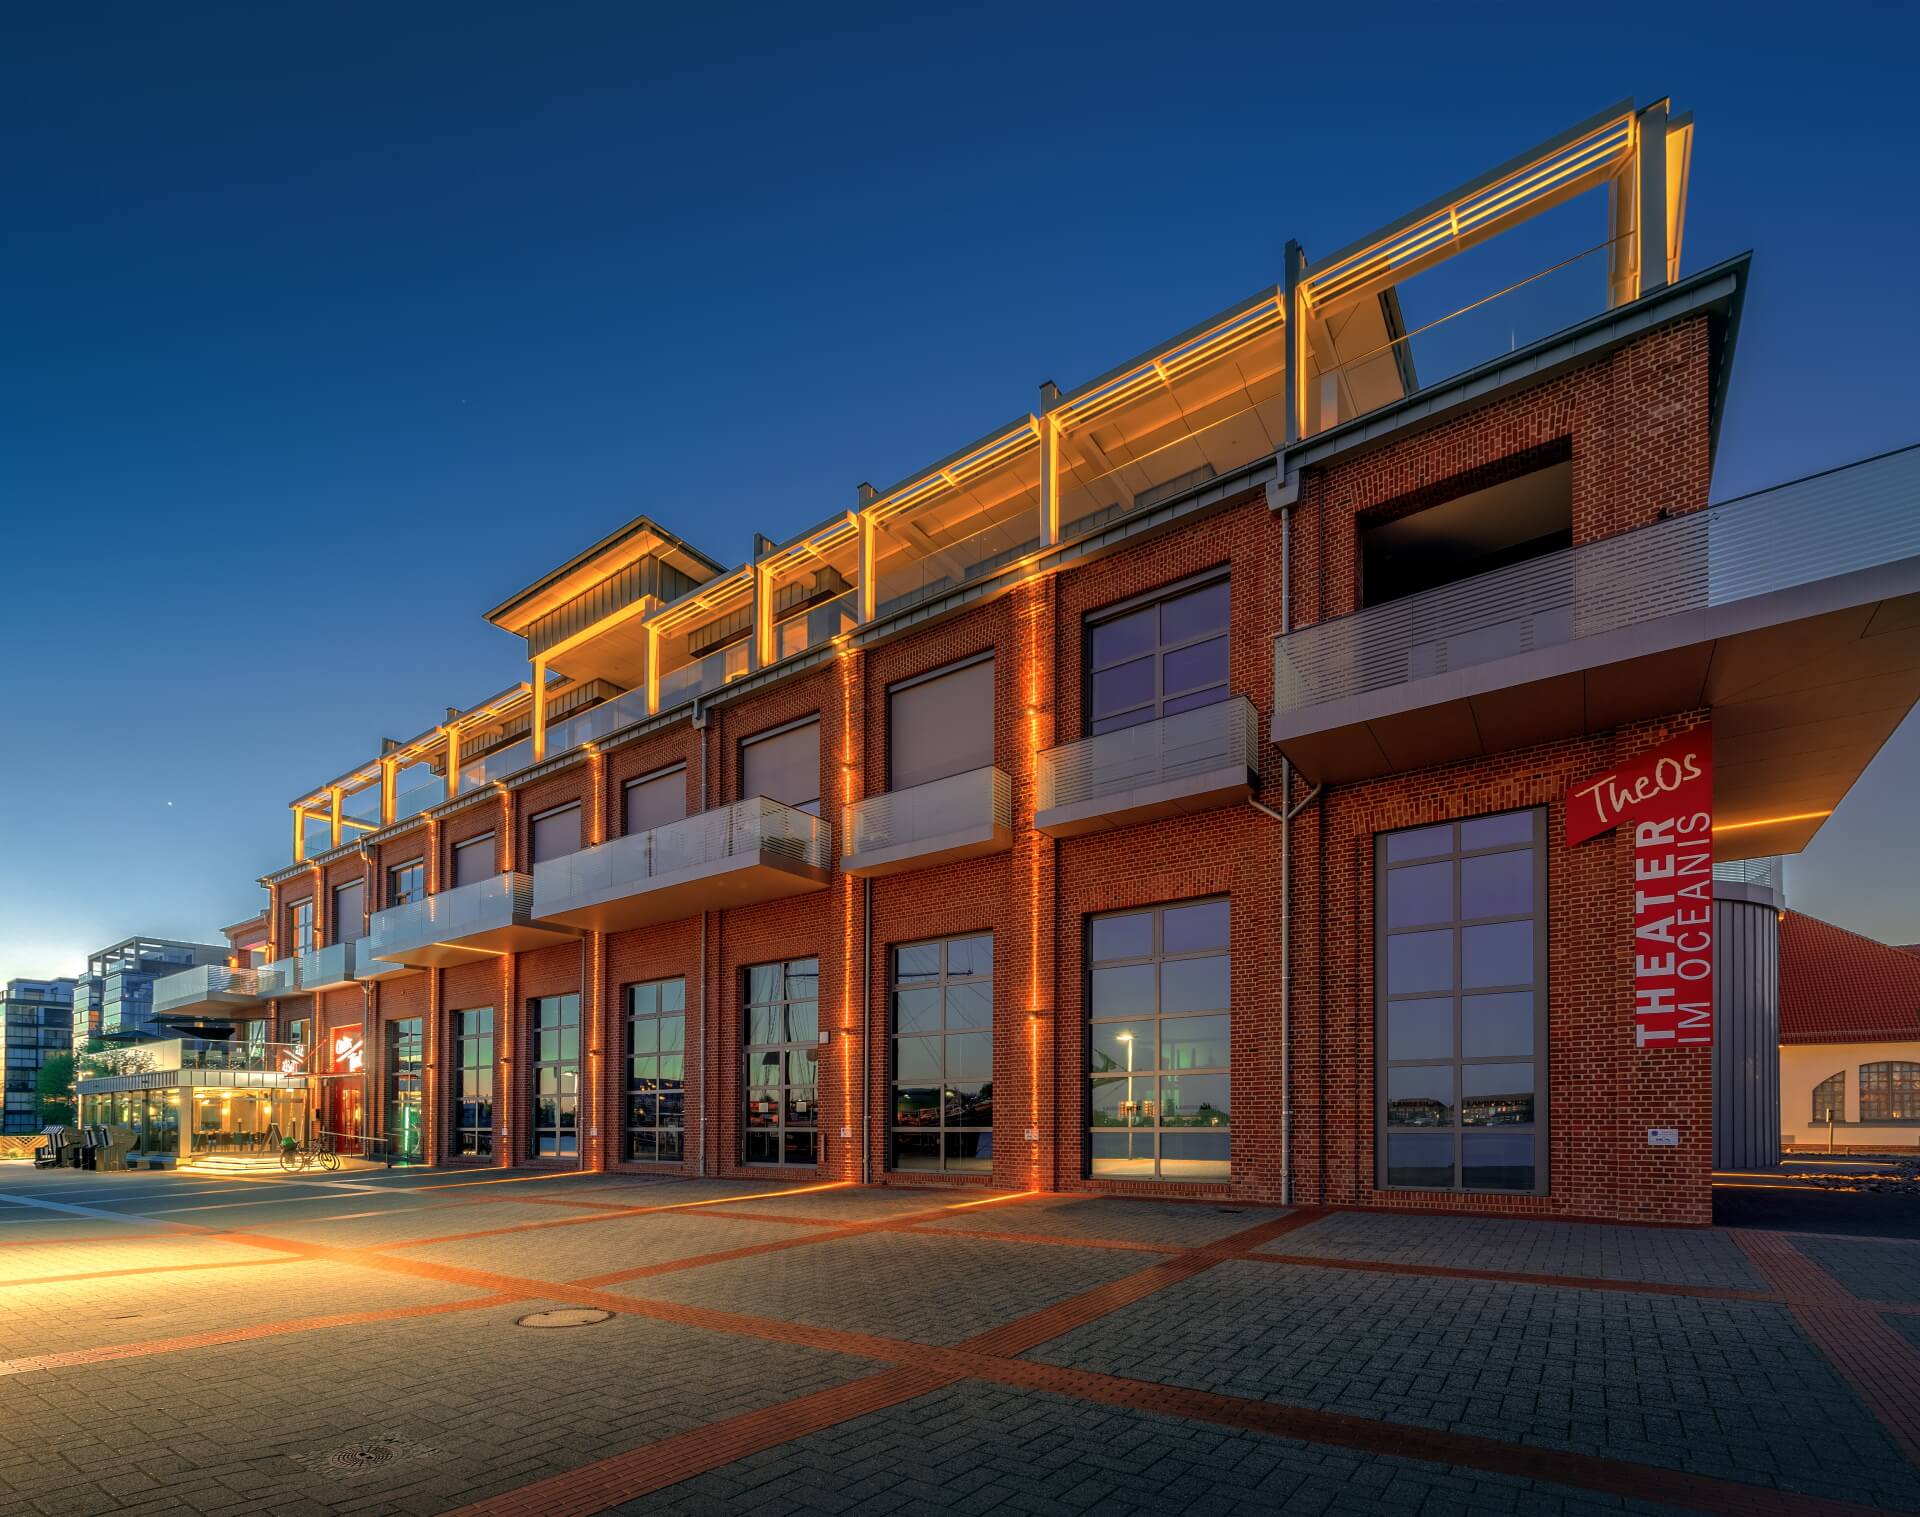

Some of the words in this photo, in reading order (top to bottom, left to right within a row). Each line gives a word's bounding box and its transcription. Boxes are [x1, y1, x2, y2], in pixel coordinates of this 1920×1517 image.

[1635, 817, 1675, 1048] THEATER
[1676, 812, 1711, 981] OCEANIS
[1677, 1002, 1710, 1043] IM
